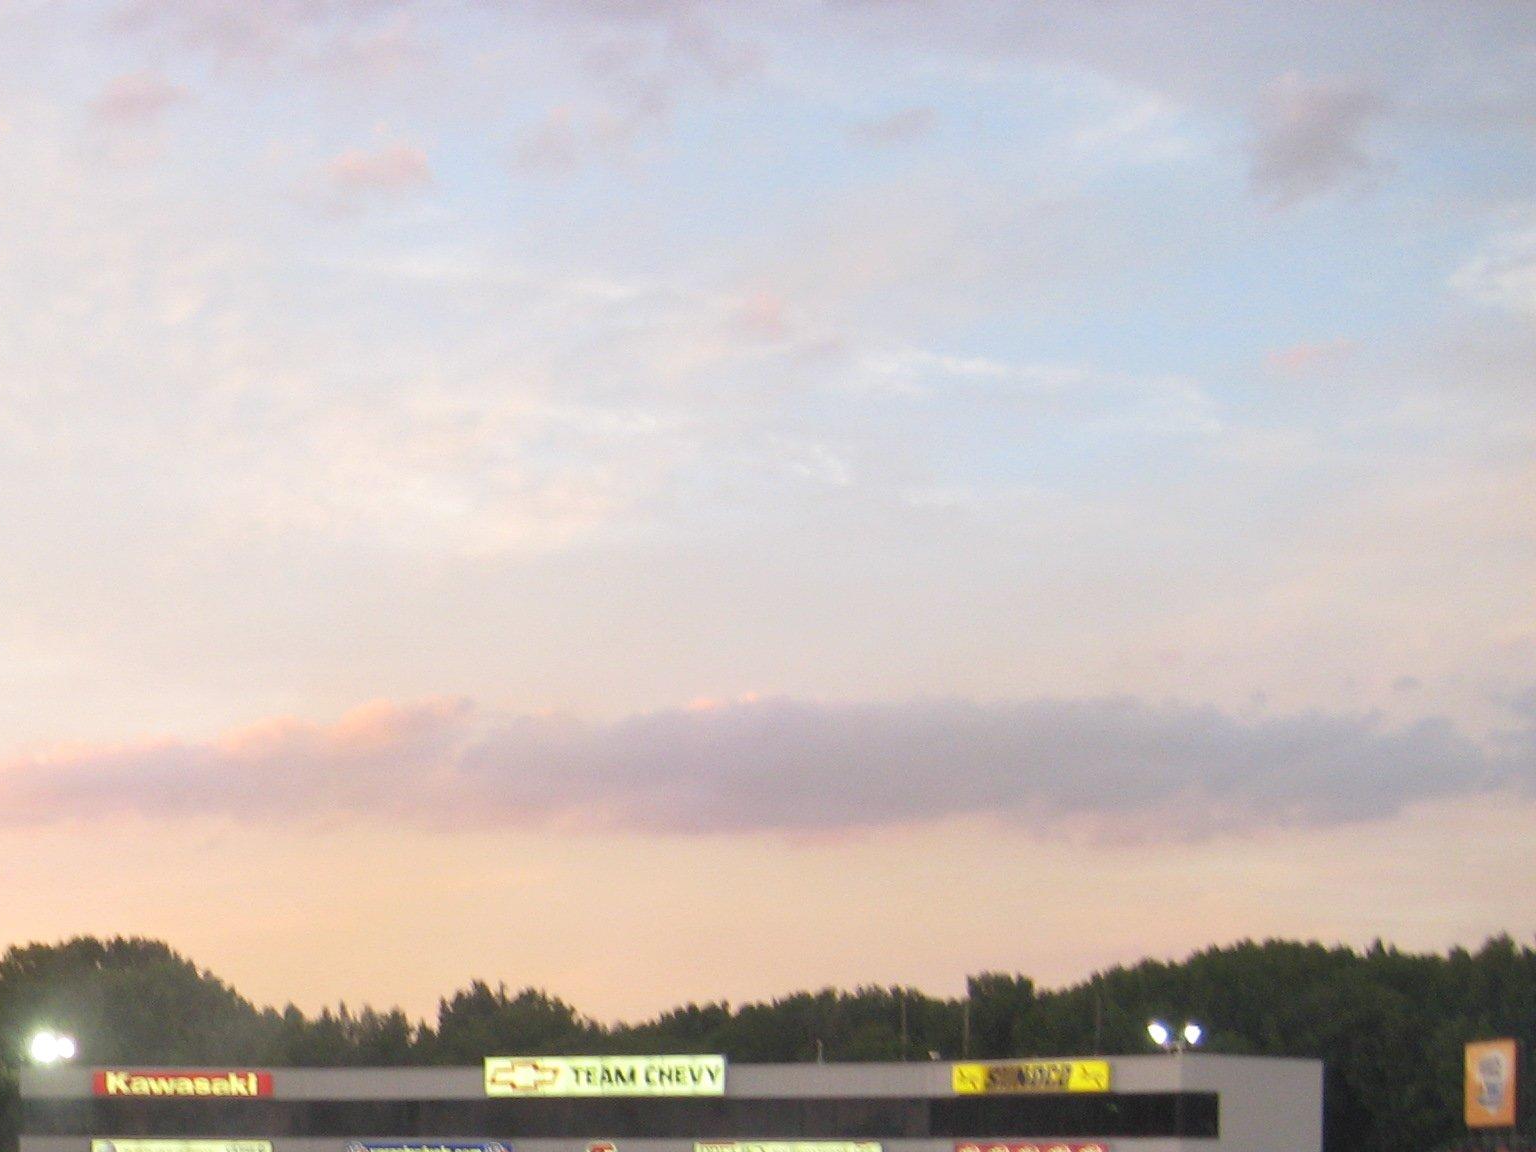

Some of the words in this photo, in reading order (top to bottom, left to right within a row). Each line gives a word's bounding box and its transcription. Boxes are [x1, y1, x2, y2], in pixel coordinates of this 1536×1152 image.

[104, 1070, 259, 1096] Kawasaki
[569, 1064, 637, 1086] TEAM
[644, 1064, 721, 1086] CHEVY
